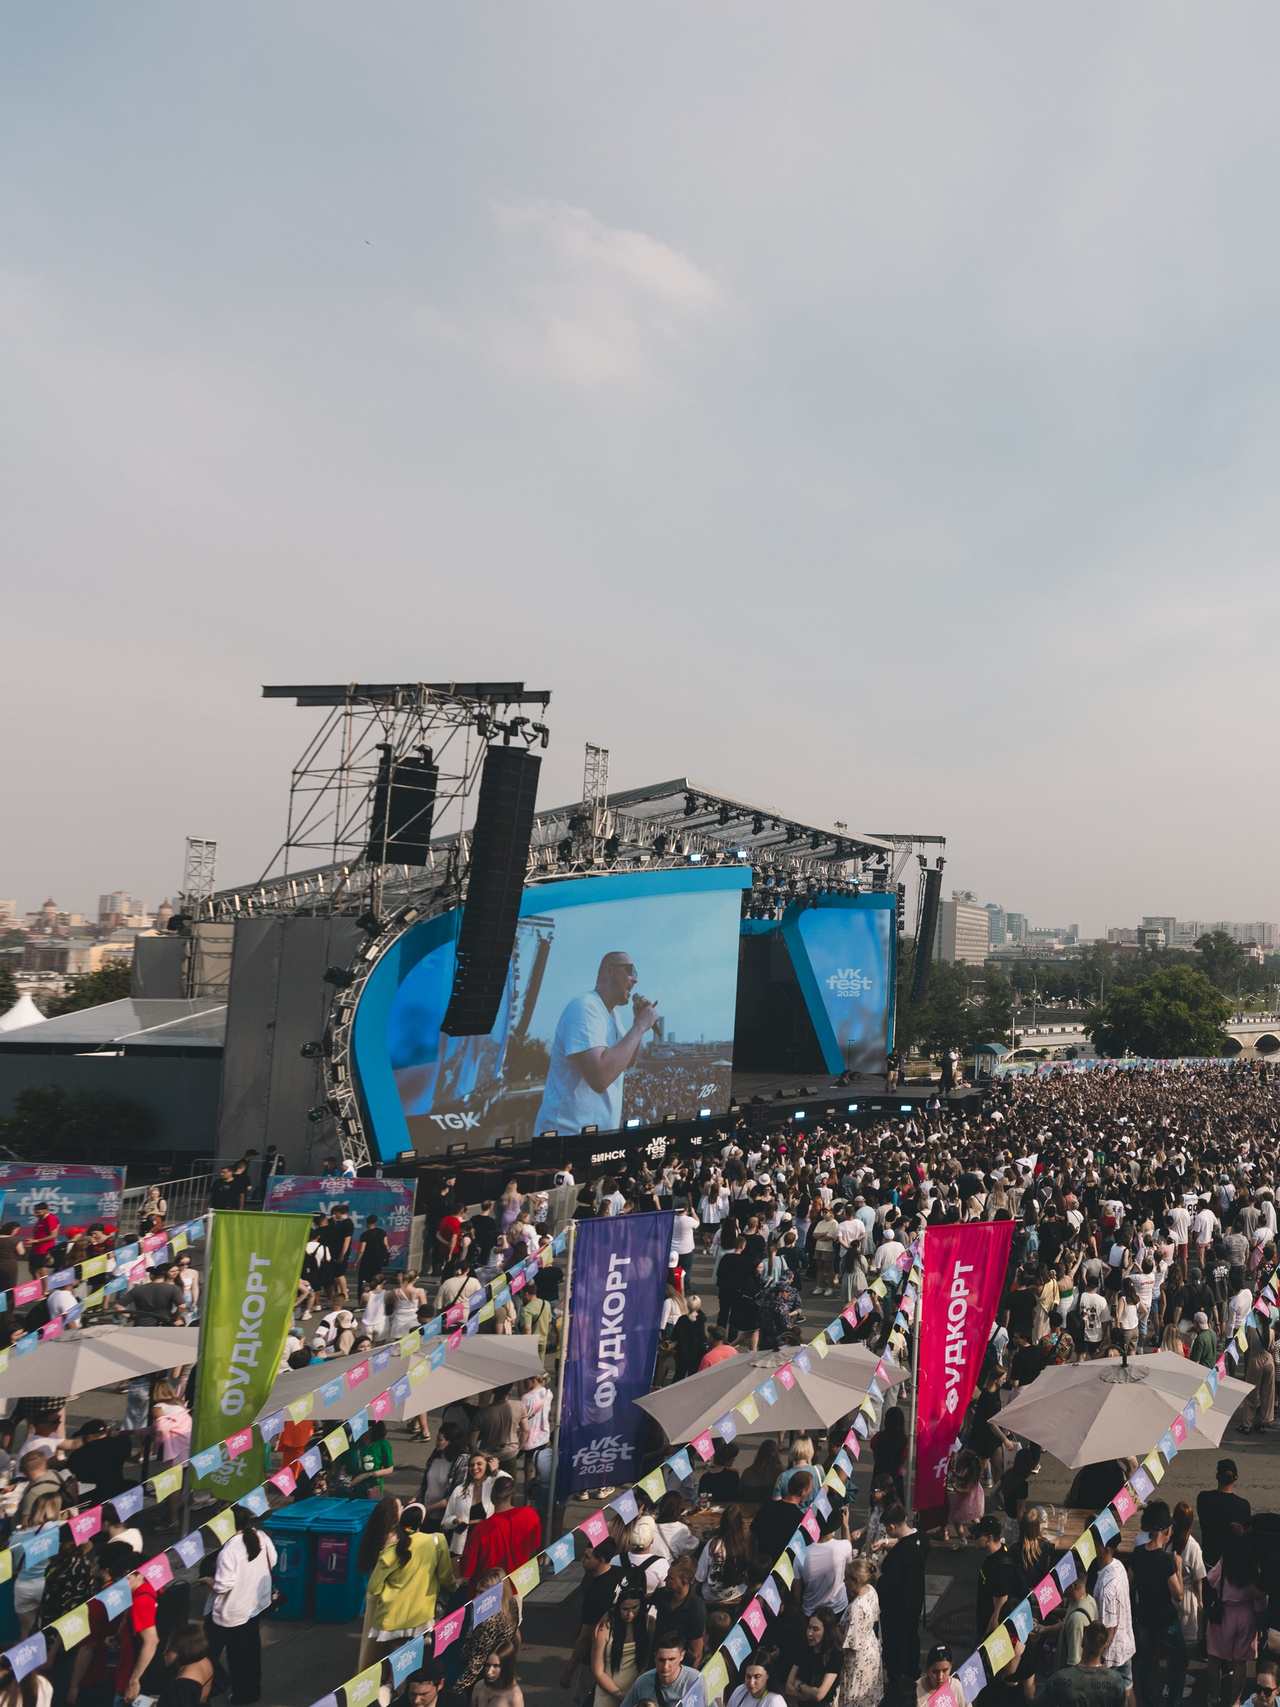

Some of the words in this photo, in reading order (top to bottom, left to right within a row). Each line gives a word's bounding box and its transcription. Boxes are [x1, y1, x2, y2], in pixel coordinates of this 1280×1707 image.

[837, 968, 862, 980] VK
[826, 975, 873, 991] fest
[697, 1083, 719, 1099] 18+
[430, 1112, 481, 1132] TGK
[319, 1178, 355, 1189] fest
[31, 1187, 62, 1201] VK
[394, 1205, 411, 1215] VK
[220, 1252, 271, 1416] ФУДКОРТ
[593, 1253, 632, 1408] ФУДКОРТ
[945, 1260, 974, 1414] ФУДКОРТ
[590, 1434, 623, 1451] VK
[572, 1442, 636, 1467] fest
[578, 1463, 614, 1475] 2025
[1091, 1680, 1111, 1691] HUGO
